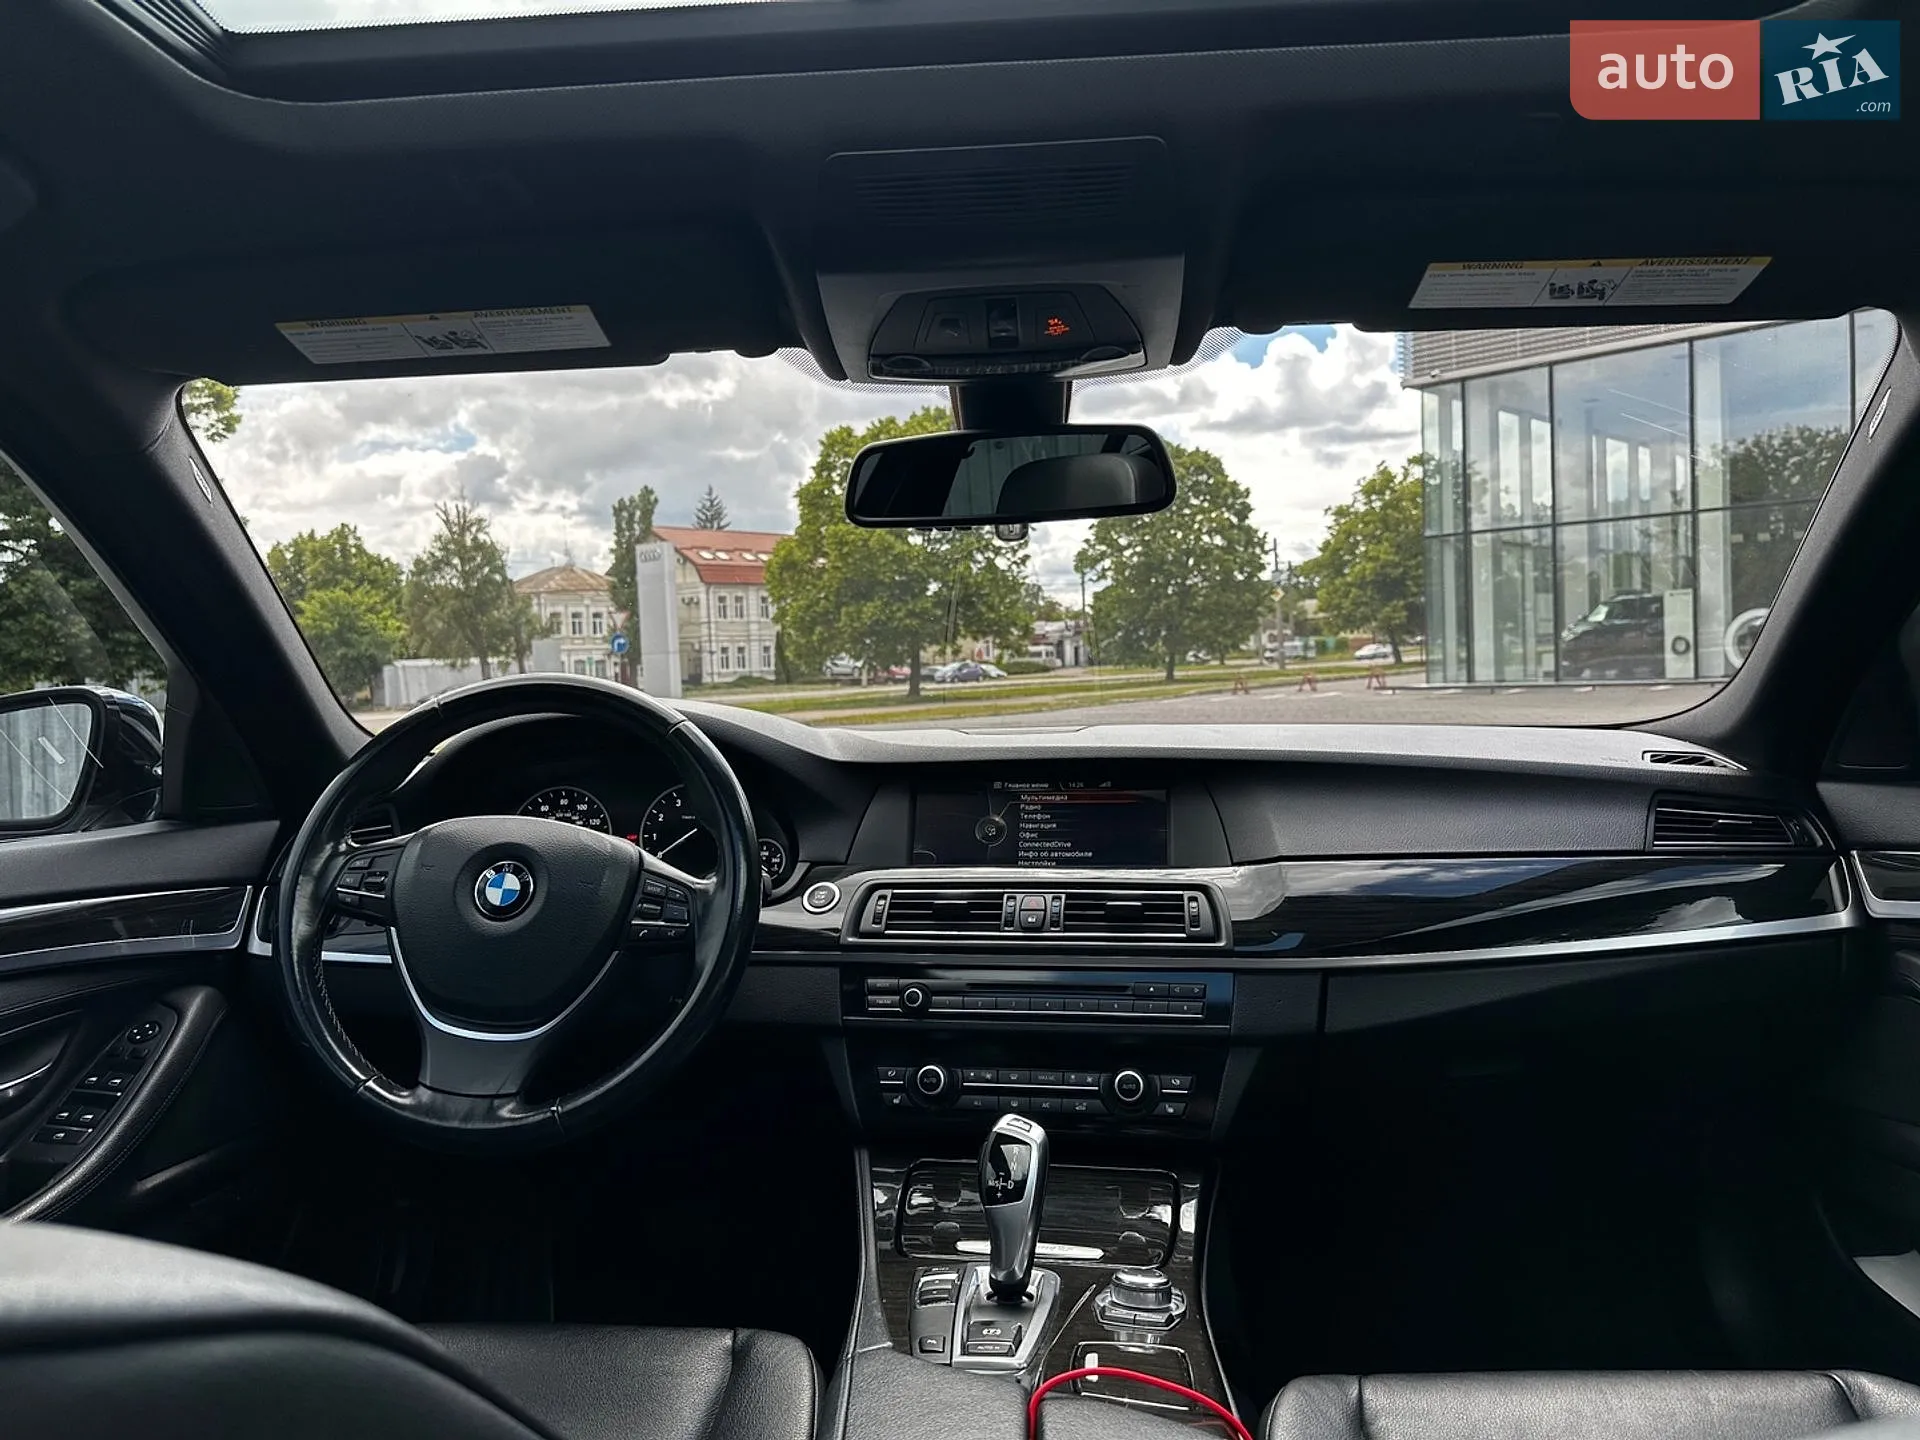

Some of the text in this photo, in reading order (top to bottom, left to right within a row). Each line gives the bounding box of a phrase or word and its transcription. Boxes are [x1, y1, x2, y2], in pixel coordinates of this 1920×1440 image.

[1462, 261, 1525, 270] WARNING
[1638, 256, 1751, 267] AVERTISSEMENT
[473, 306, 573, 319] AVERTISSEMENT
[306, 318, 368, 329] WARNING
[1020, 794, 1068, 802] Мультимедиа
[675, 798, 682, 807] 3
[540, 804, 549, 812] 60
[658, 813, 664, 821] 2
[652, 833, 657, 841] 1
[1019, 831, 1039, 839] Офис
[1018, 840, 1072, 848] ConnectedDrive
[1018, 850, 1039, 858] Инфо
[1007, 1180, 1015, 1189] D
